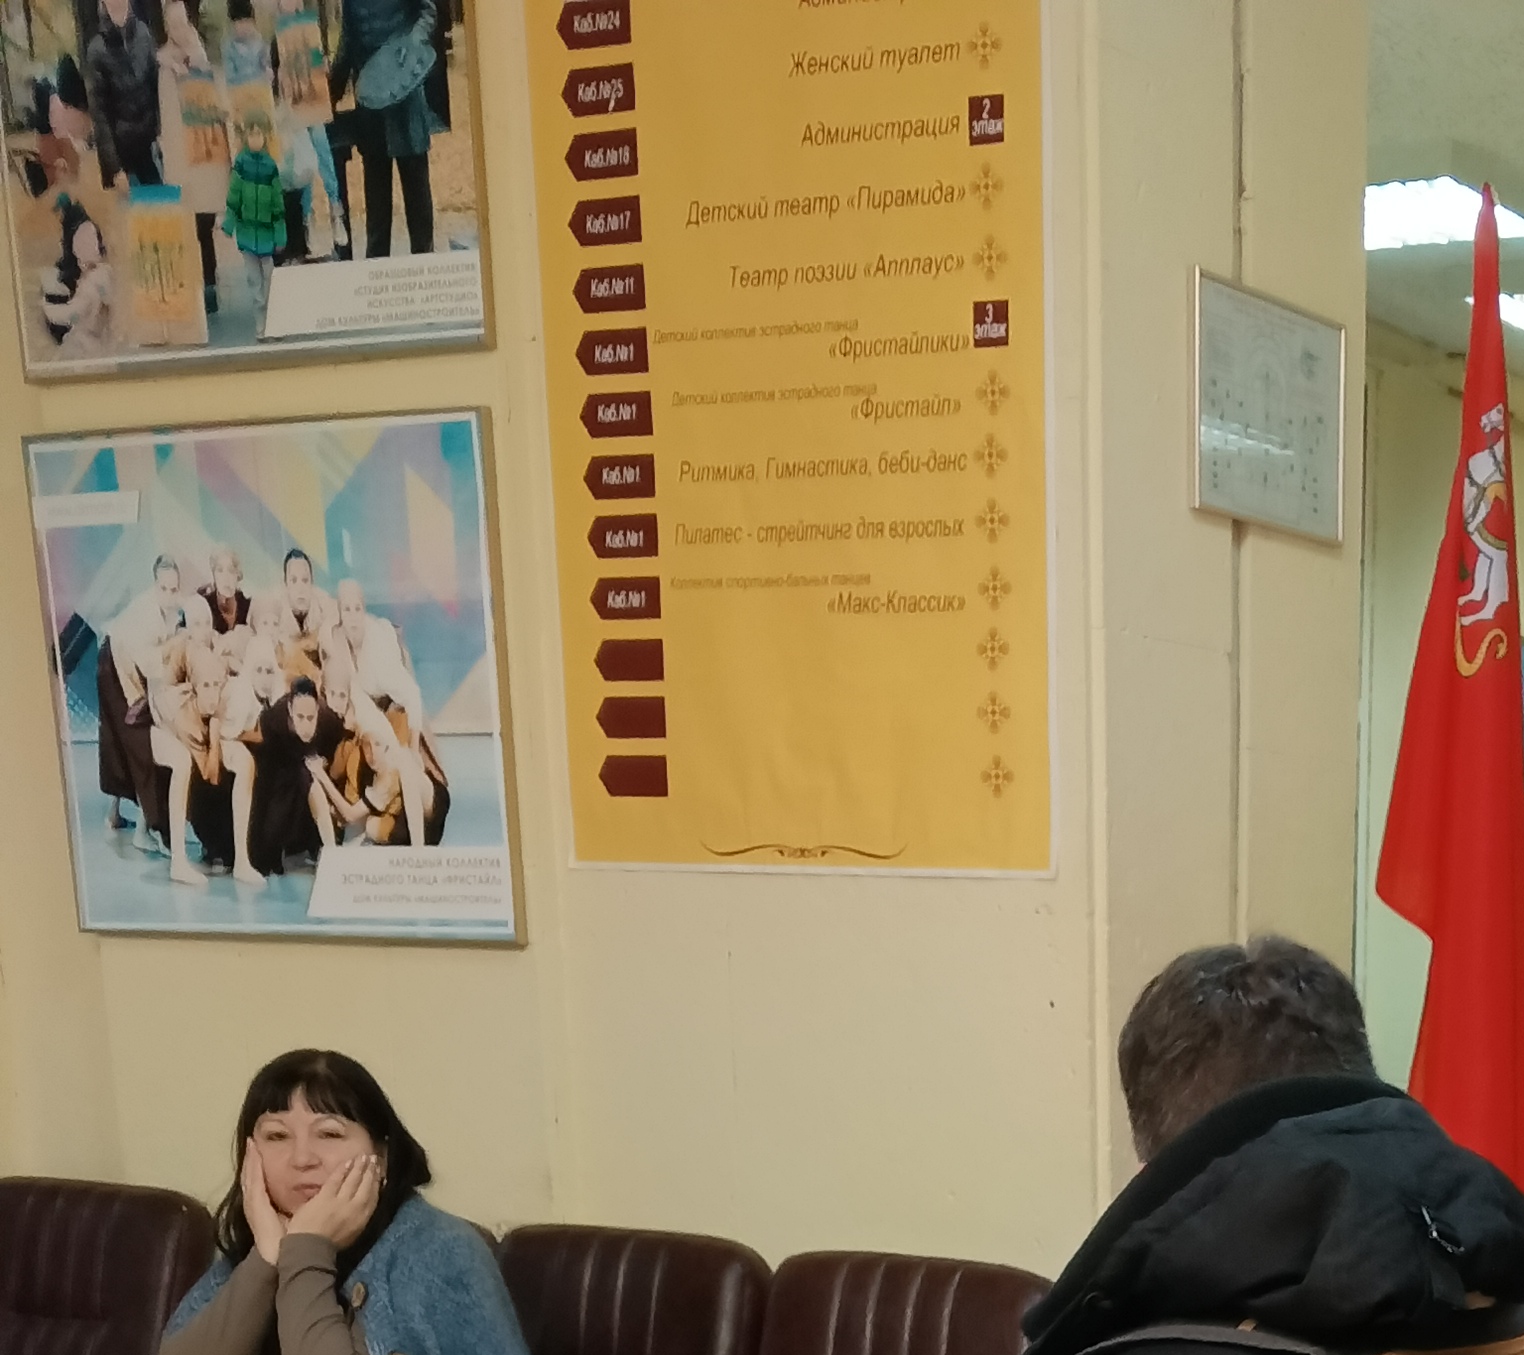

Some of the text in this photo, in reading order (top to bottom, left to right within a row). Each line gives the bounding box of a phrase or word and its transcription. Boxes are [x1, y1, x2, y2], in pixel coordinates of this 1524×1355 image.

[788, 40, 961, 78] Женский туалет
[981, 97, 991, 119] 2
[801, 113, 961, 148] Администрация
[686, 180, 966, 229] Детский театр «Пирамида»
[730, 253, 965, 291] Театр поэзии «Апплаус»
[984, 303, 994, 323] 3
[653, 328, 698, 344] Детский
[829, 331, 970, 363] «Фристайлики»
[851, 393, 962, 424] «Фристайл»
[679, 449, 968, 485] Ритмика, Гимнастика, беби-данс
[675, 522, 743, 547] Пилатес
[756, 518, 851, 547] стрейтчинг
[857, 516, 885, 541] для
[888, 515, 966, 539] взрослых
[827, 590, 967, 614] «Макс-Классик»
[341, 873, 404, 885] ЭСТРАДНОГО
[407, 873, 438, 886] ТАНЦА
